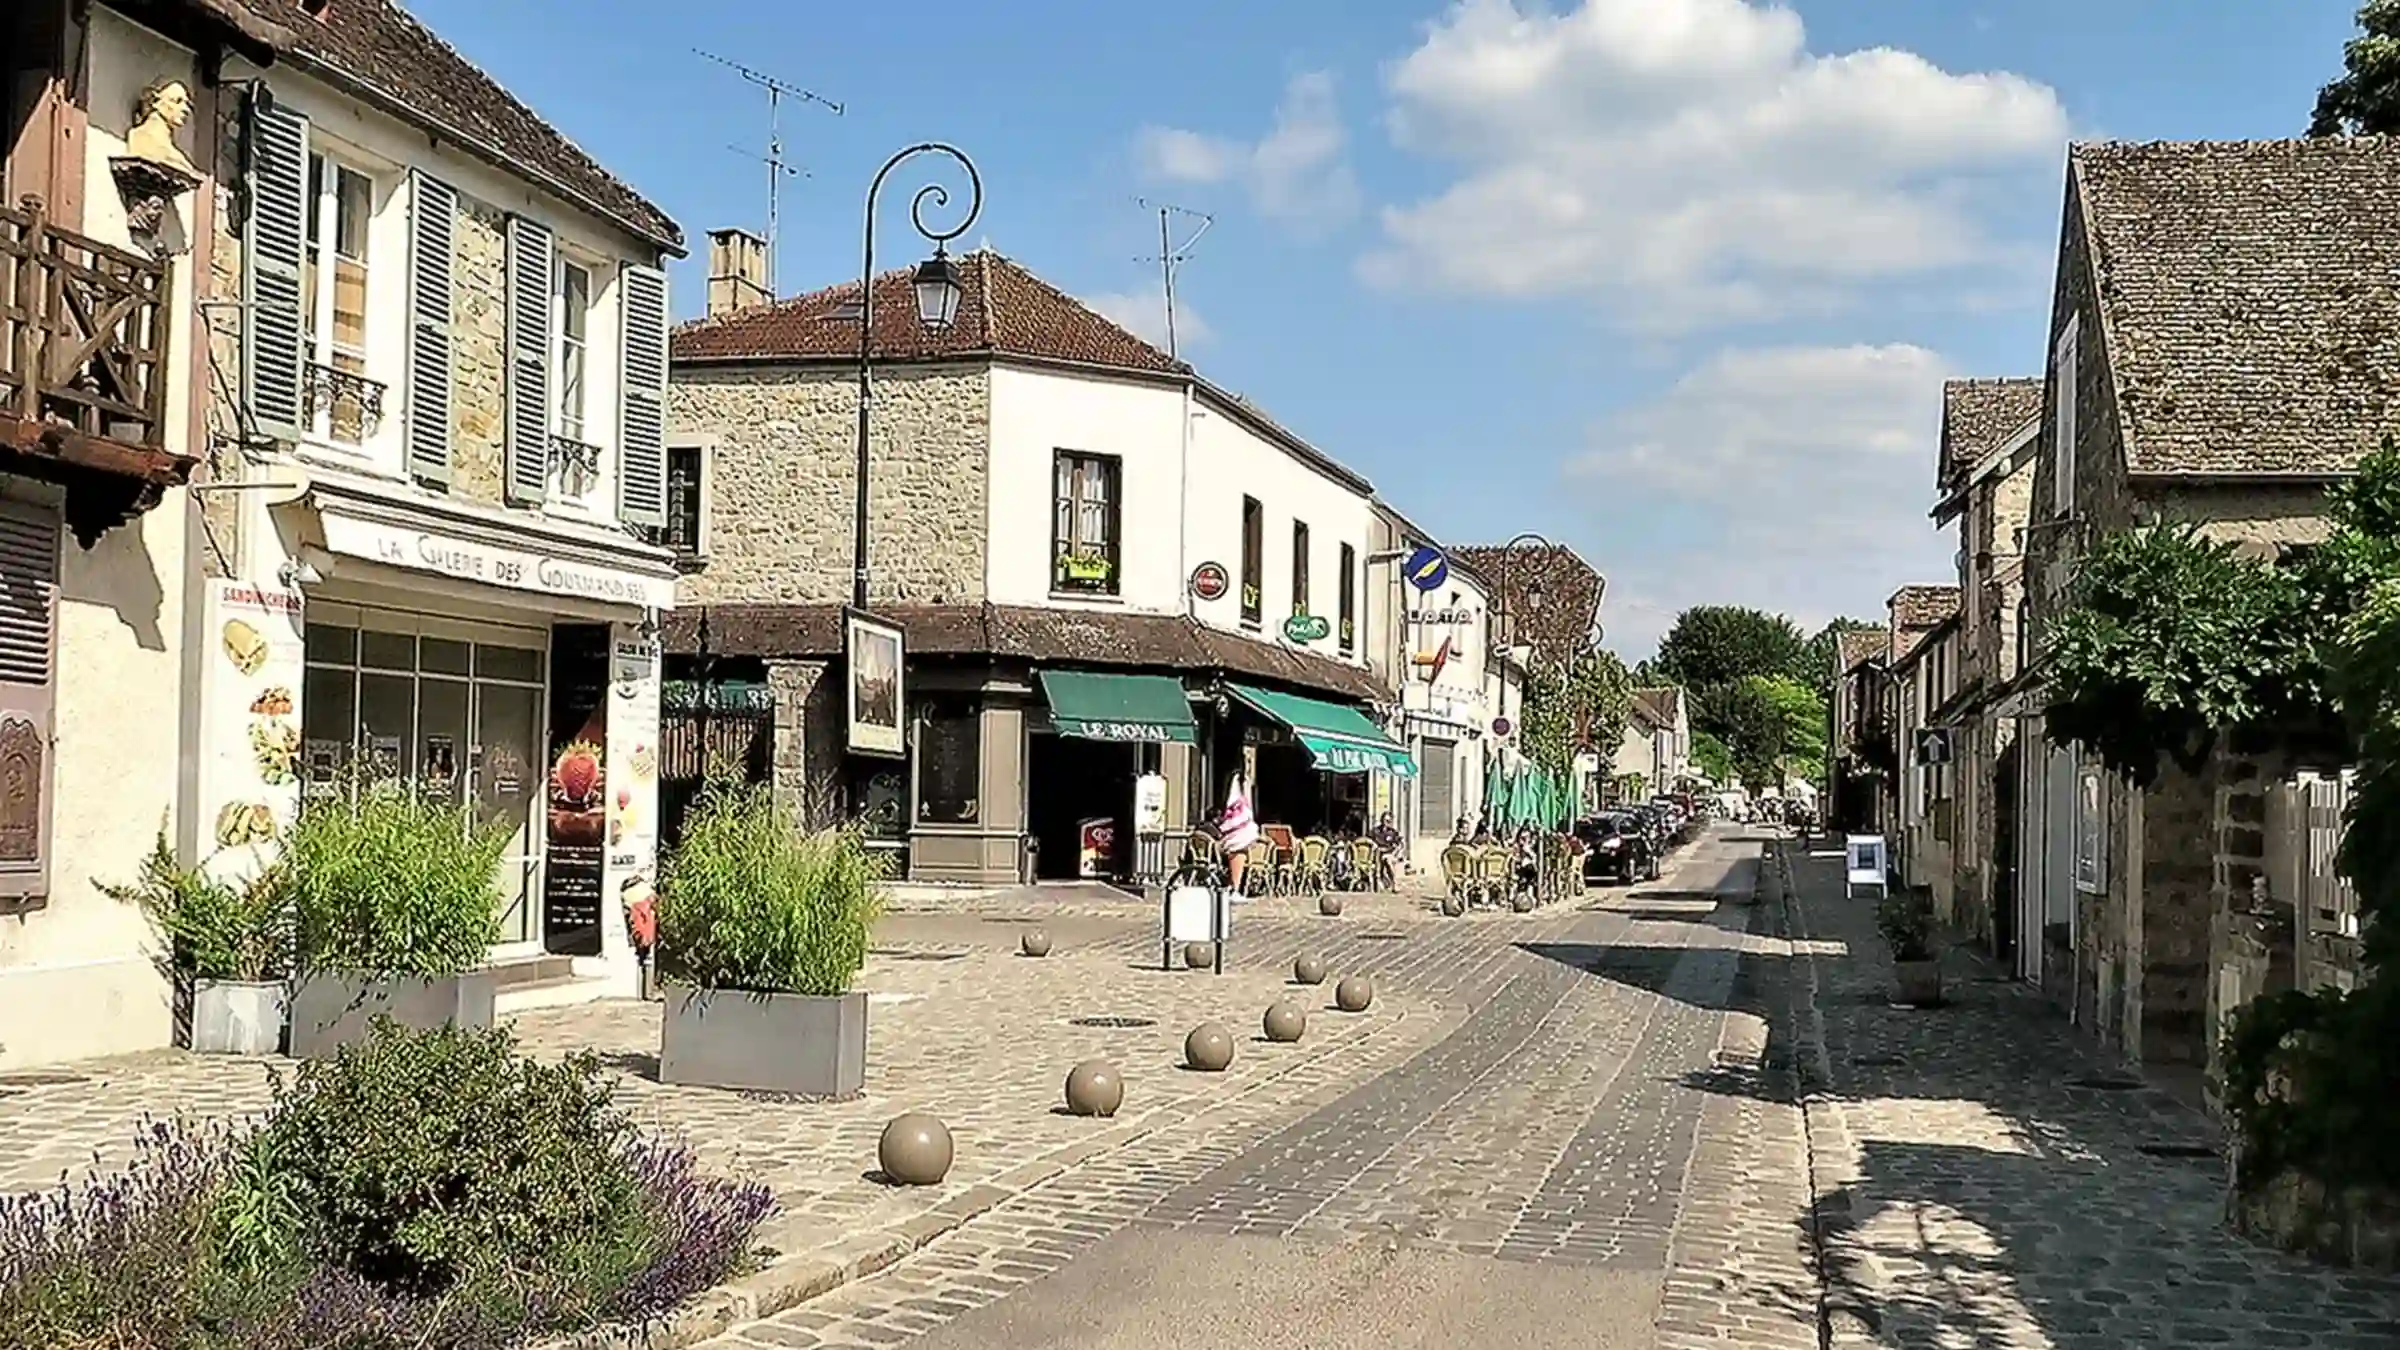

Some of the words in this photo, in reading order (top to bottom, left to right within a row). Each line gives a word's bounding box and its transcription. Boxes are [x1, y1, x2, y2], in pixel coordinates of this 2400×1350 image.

[378, 537, 404, 560] LA
[495, 560, 522, 583] DES
[1079, 722, 1105, 740] LE
[1110, 723, 1171, 741] ROYAL
